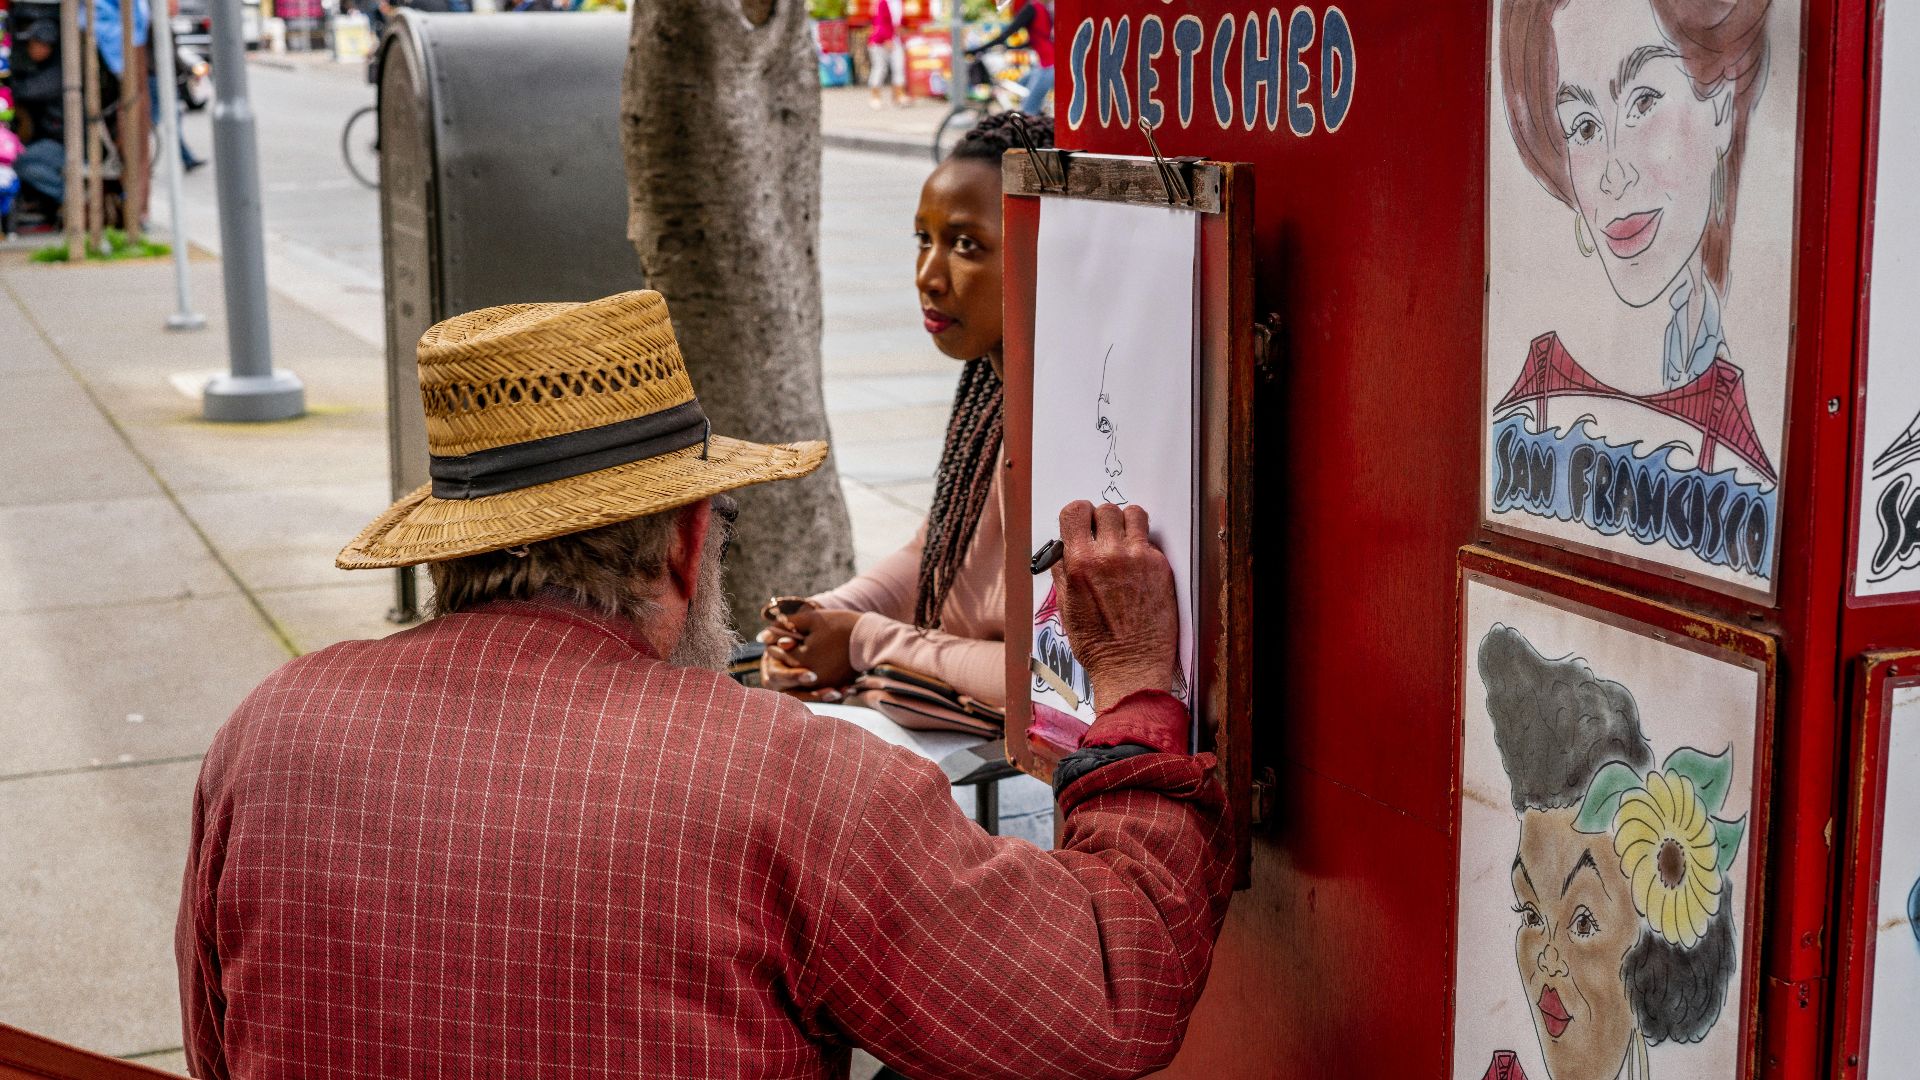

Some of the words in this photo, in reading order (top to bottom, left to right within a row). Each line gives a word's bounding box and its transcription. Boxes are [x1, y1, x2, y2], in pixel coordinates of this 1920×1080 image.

[1067, 5, 1356, 137] SKETCHED
[1495, 423, 1556, 508] SAN
[1567, 443, 1768, 575] FRANCISCO
